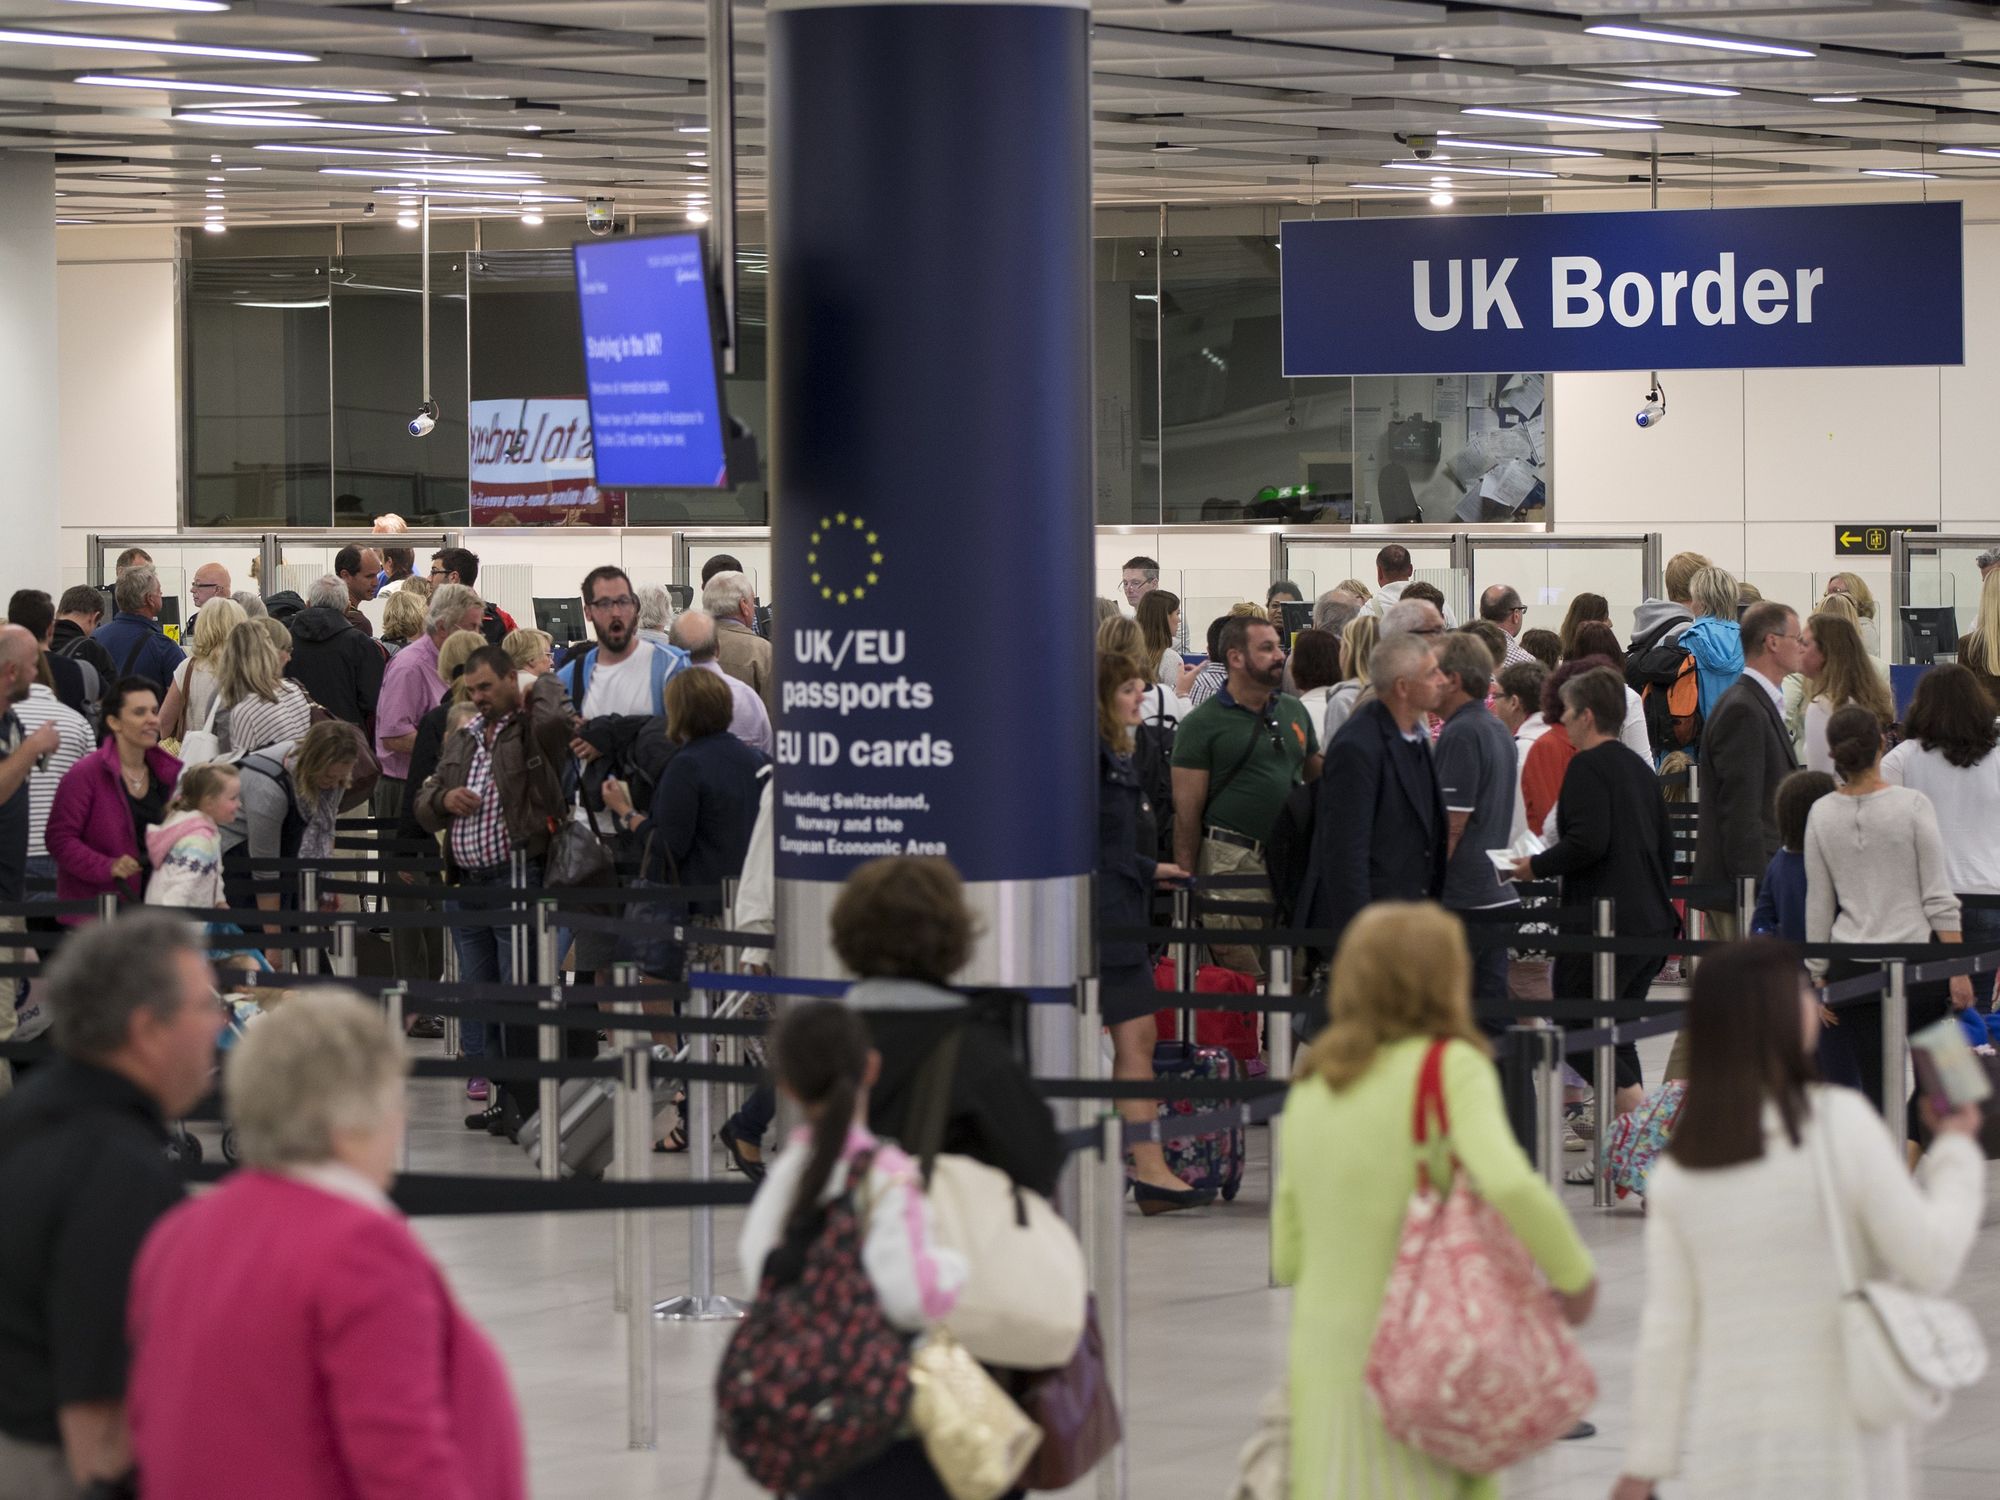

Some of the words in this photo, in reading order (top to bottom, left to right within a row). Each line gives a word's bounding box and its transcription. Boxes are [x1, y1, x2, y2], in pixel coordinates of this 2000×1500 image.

[1412, 257, 1524, 331] UK
[1551, 251, 1824, 328] Border
[794, 629, 906, 672] UK/EU
[782, 675, 934, 716] passports
[776, 730, 801, 765] EU
[808, 731, 840, 766] ID
[848, 732, 954, 767] cards
[782, 790, 831, 812] Including
[832, 792, 930, 812] Switzerland,
[795, 813, 840, 836] Norway
[843, 816, 872, 833] and
[874, 816, 904, 833] the
[826, 838, 902, 855] Economic
[905, 838, 947, 855] Area
